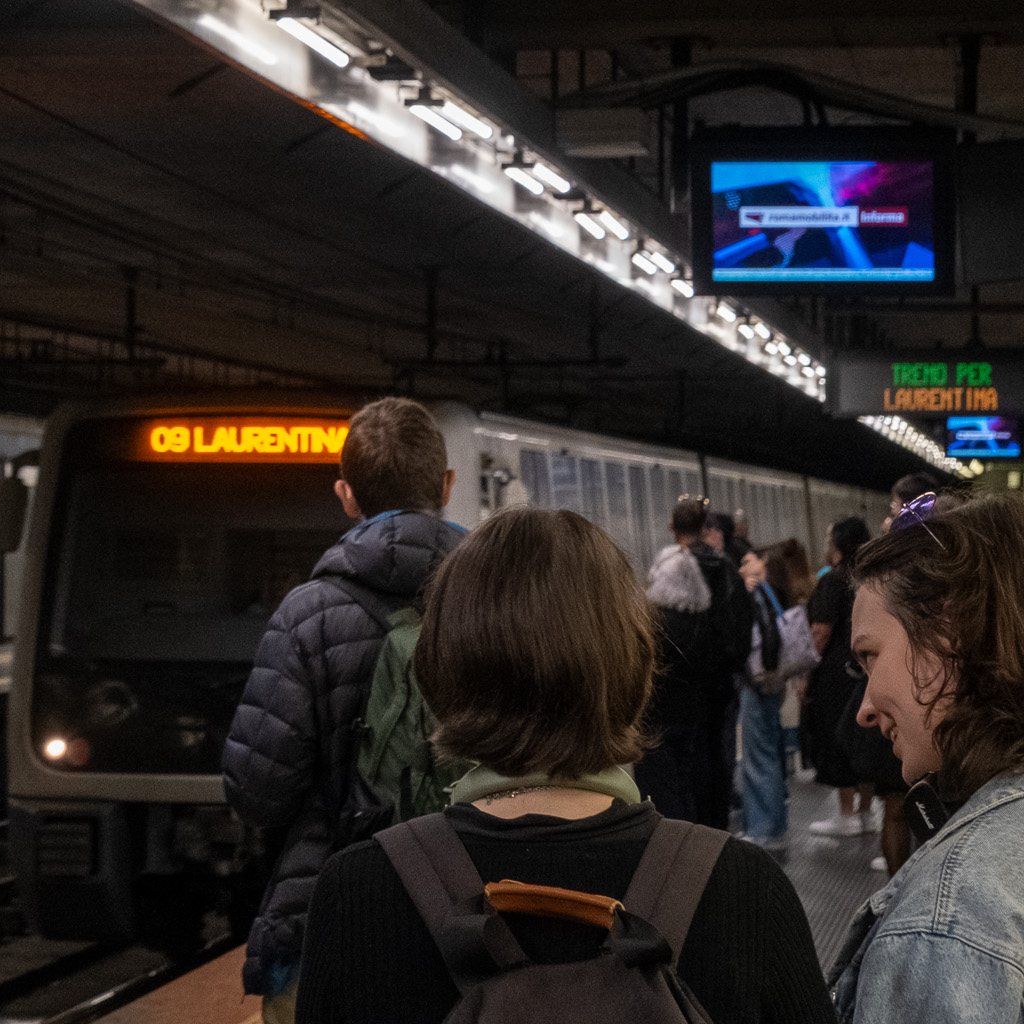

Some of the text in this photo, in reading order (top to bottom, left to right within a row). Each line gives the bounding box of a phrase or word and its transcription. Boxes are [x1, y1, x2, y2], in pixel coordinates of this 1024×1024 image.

[956, 362, 992, 386] PER
[883, 387, 998, 411] LAURENTINA
[150, 426, 191, 453] 09
